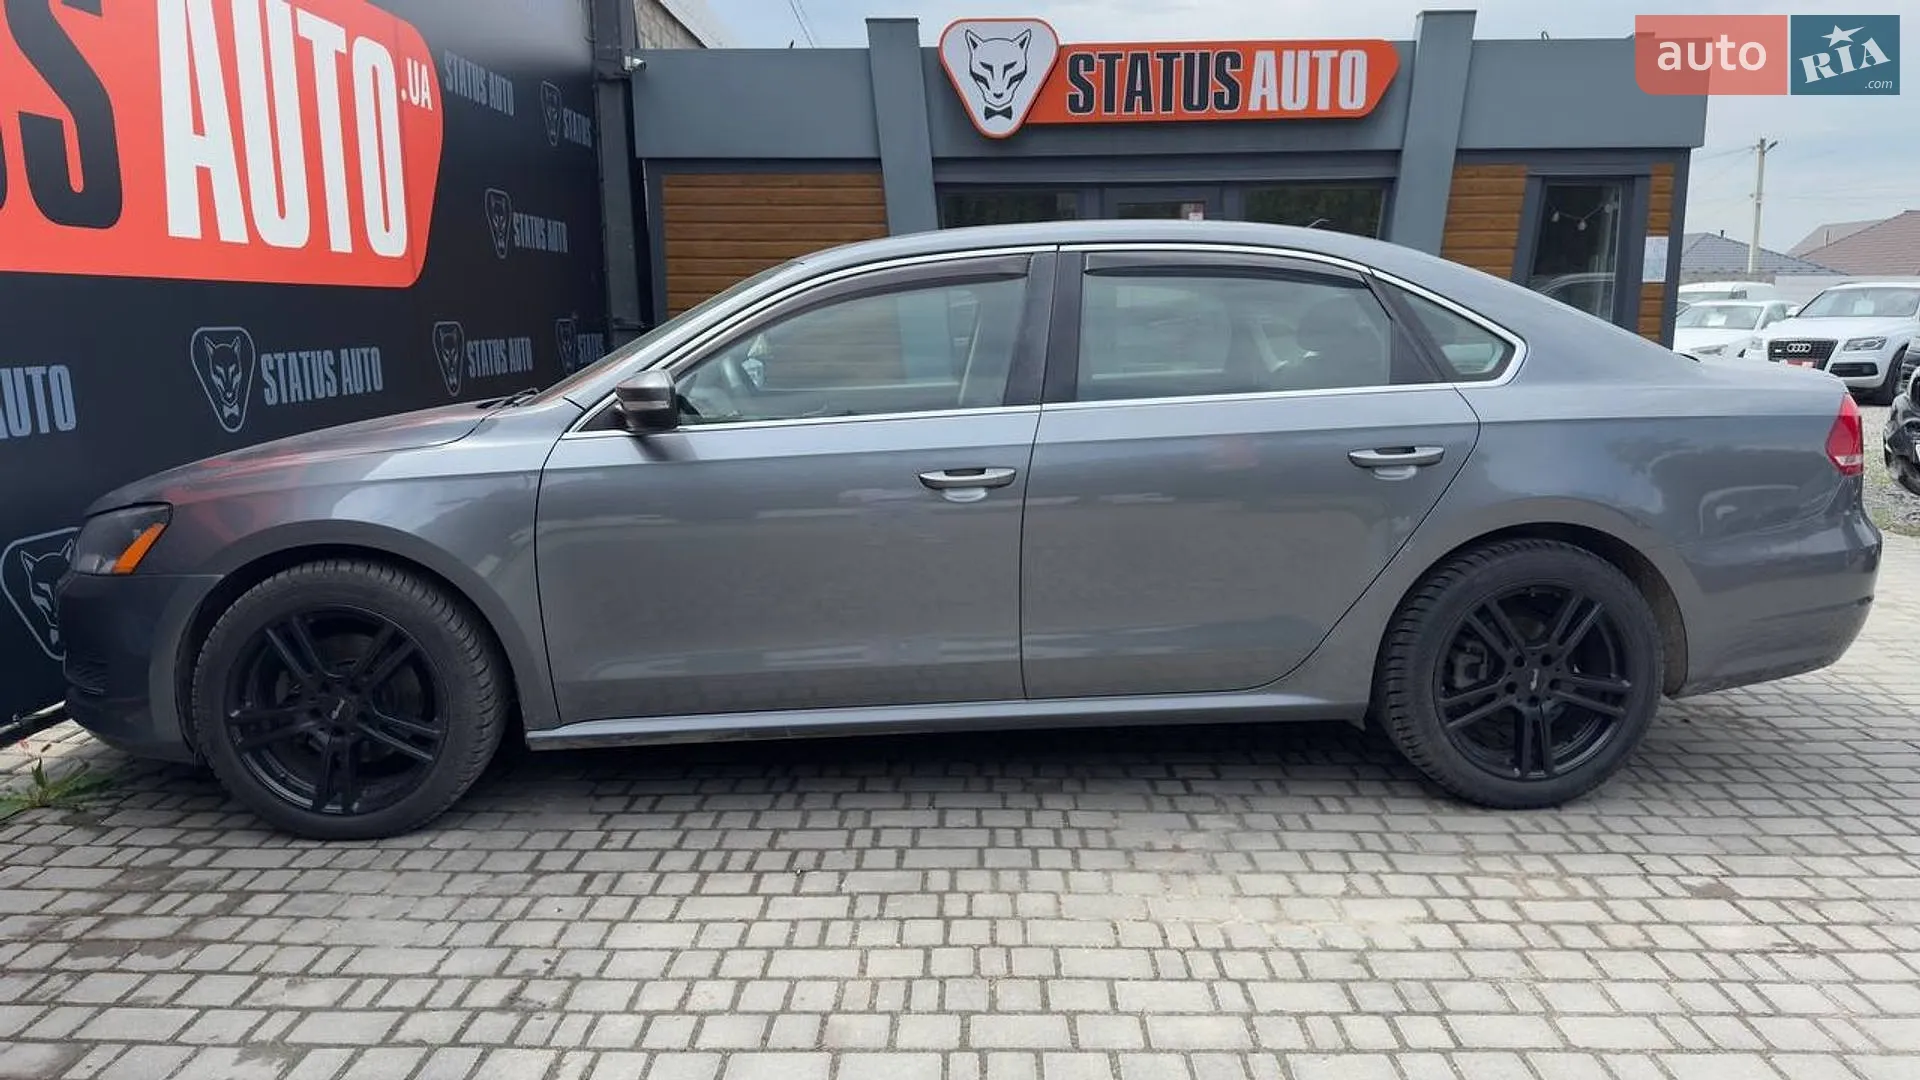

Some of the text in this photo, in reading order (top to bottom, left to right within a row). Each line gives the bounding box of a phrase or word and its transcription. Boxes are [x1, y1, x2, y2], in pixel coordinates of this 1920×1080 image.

[444, 50, 515, 117] STATUS AUTO
[1067, 49, 1368, 115] STATUS AUTO
[562, 107, 592, 148] STATUS
[512, 212, 569, 253] STATUS AUTO
[260, 347, 383, 406] STATUS AUTO
[466, 337, 534, 378] STATUS AUTO
[0, 365, 77, 439] UTO
